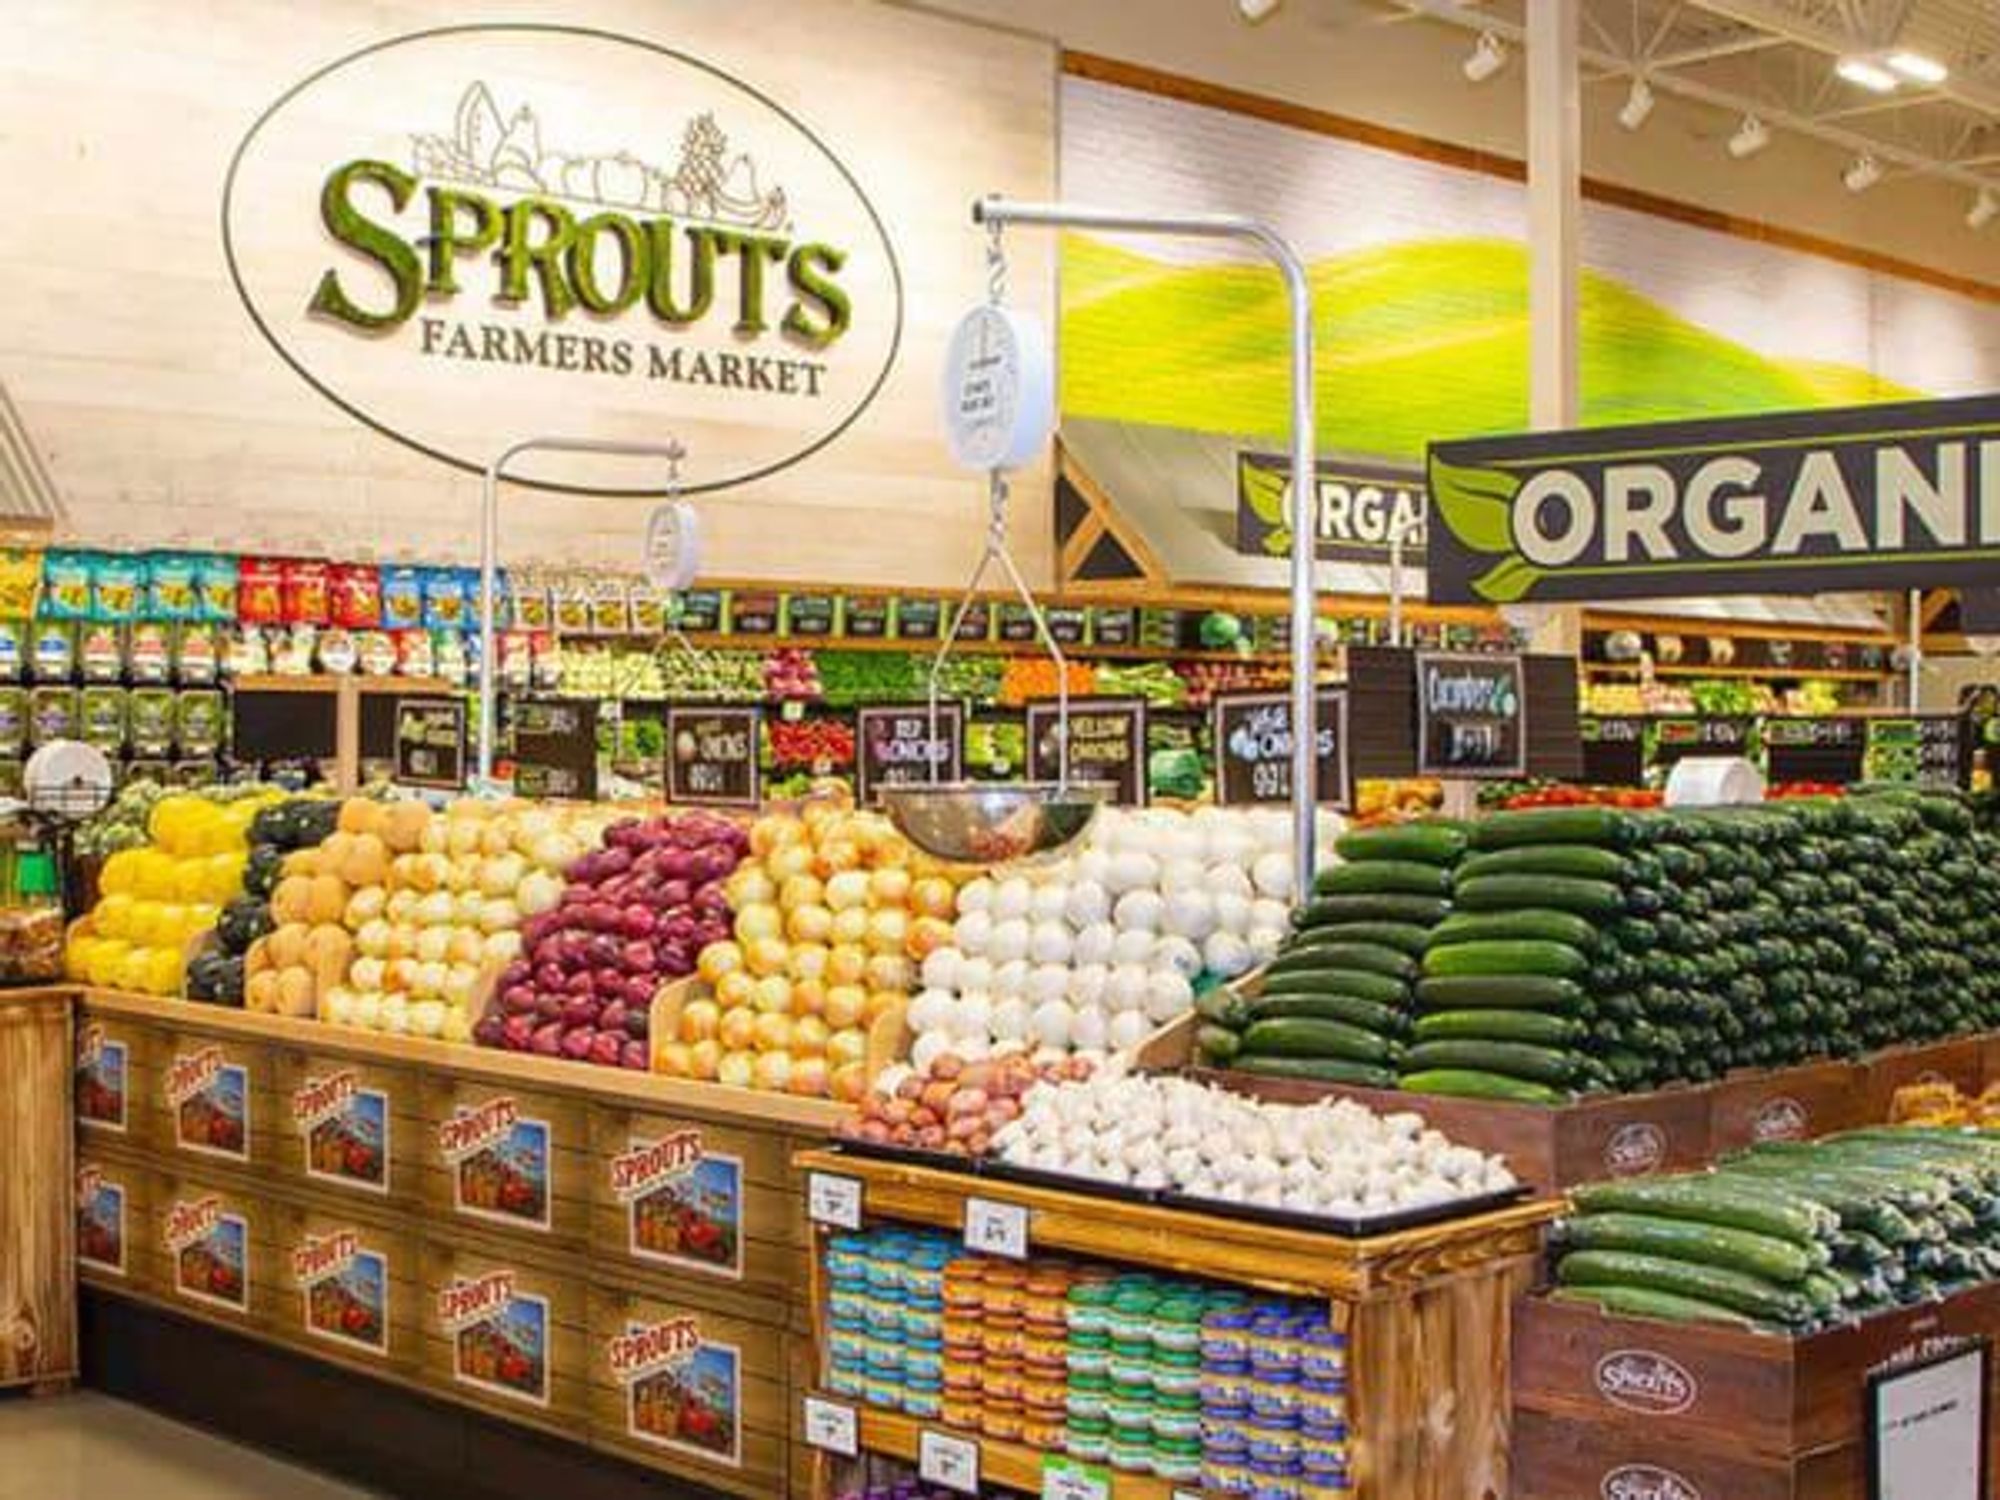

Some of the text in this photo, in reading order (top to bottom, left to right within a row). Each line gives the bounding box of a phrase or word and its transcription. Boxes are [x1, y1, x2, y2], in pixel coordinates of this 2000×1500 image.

[307, 157, 852, 347] SPROUTS
[420, 318, 828, 397] FARMERS MARKET
[612, 1130, 703, 1189] SPROUTS
[609, 1317, 699, 1369] SPROUTS
